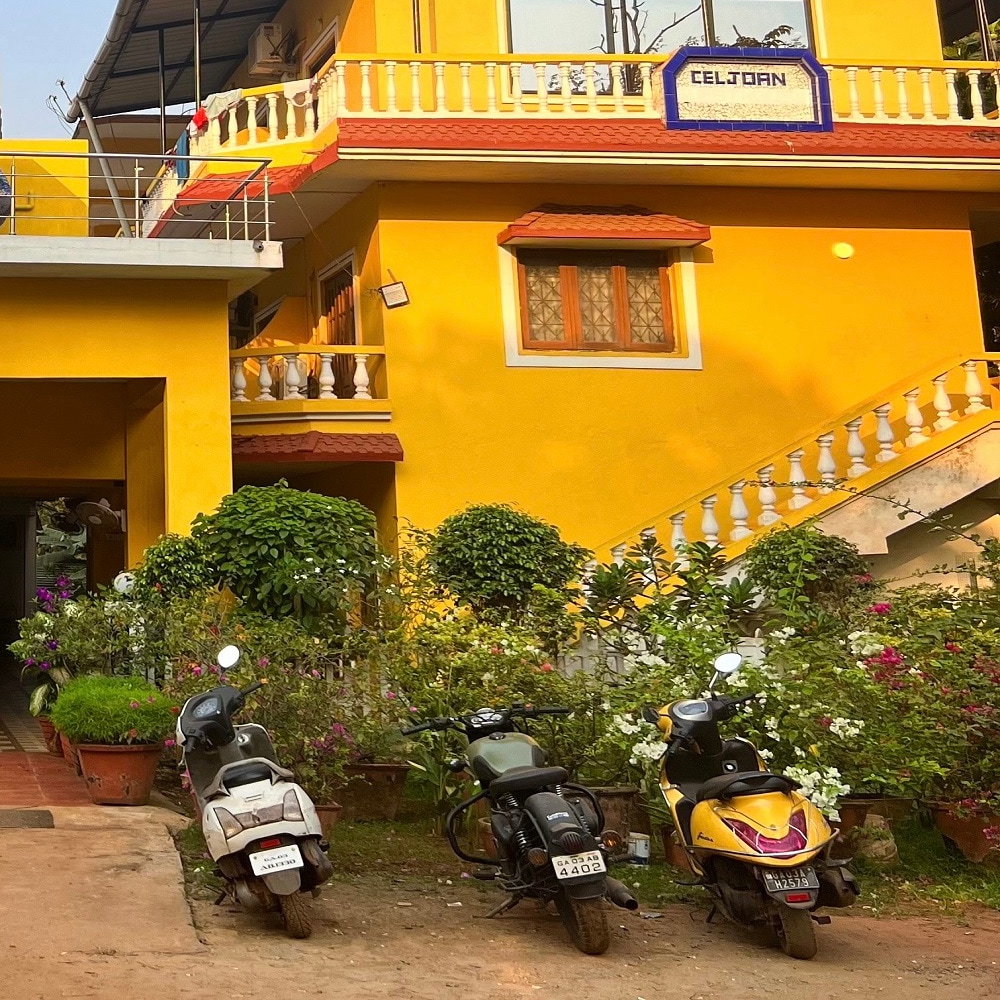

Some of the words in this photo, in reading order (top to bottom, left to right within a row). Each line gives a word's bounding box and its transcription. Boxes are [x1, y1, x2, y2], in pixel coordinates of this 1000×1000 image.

[691, 70, 787, 87] CELJOAN
[559, 862, 602, 877] 4402
[774, 877, 810, 889] H2579
